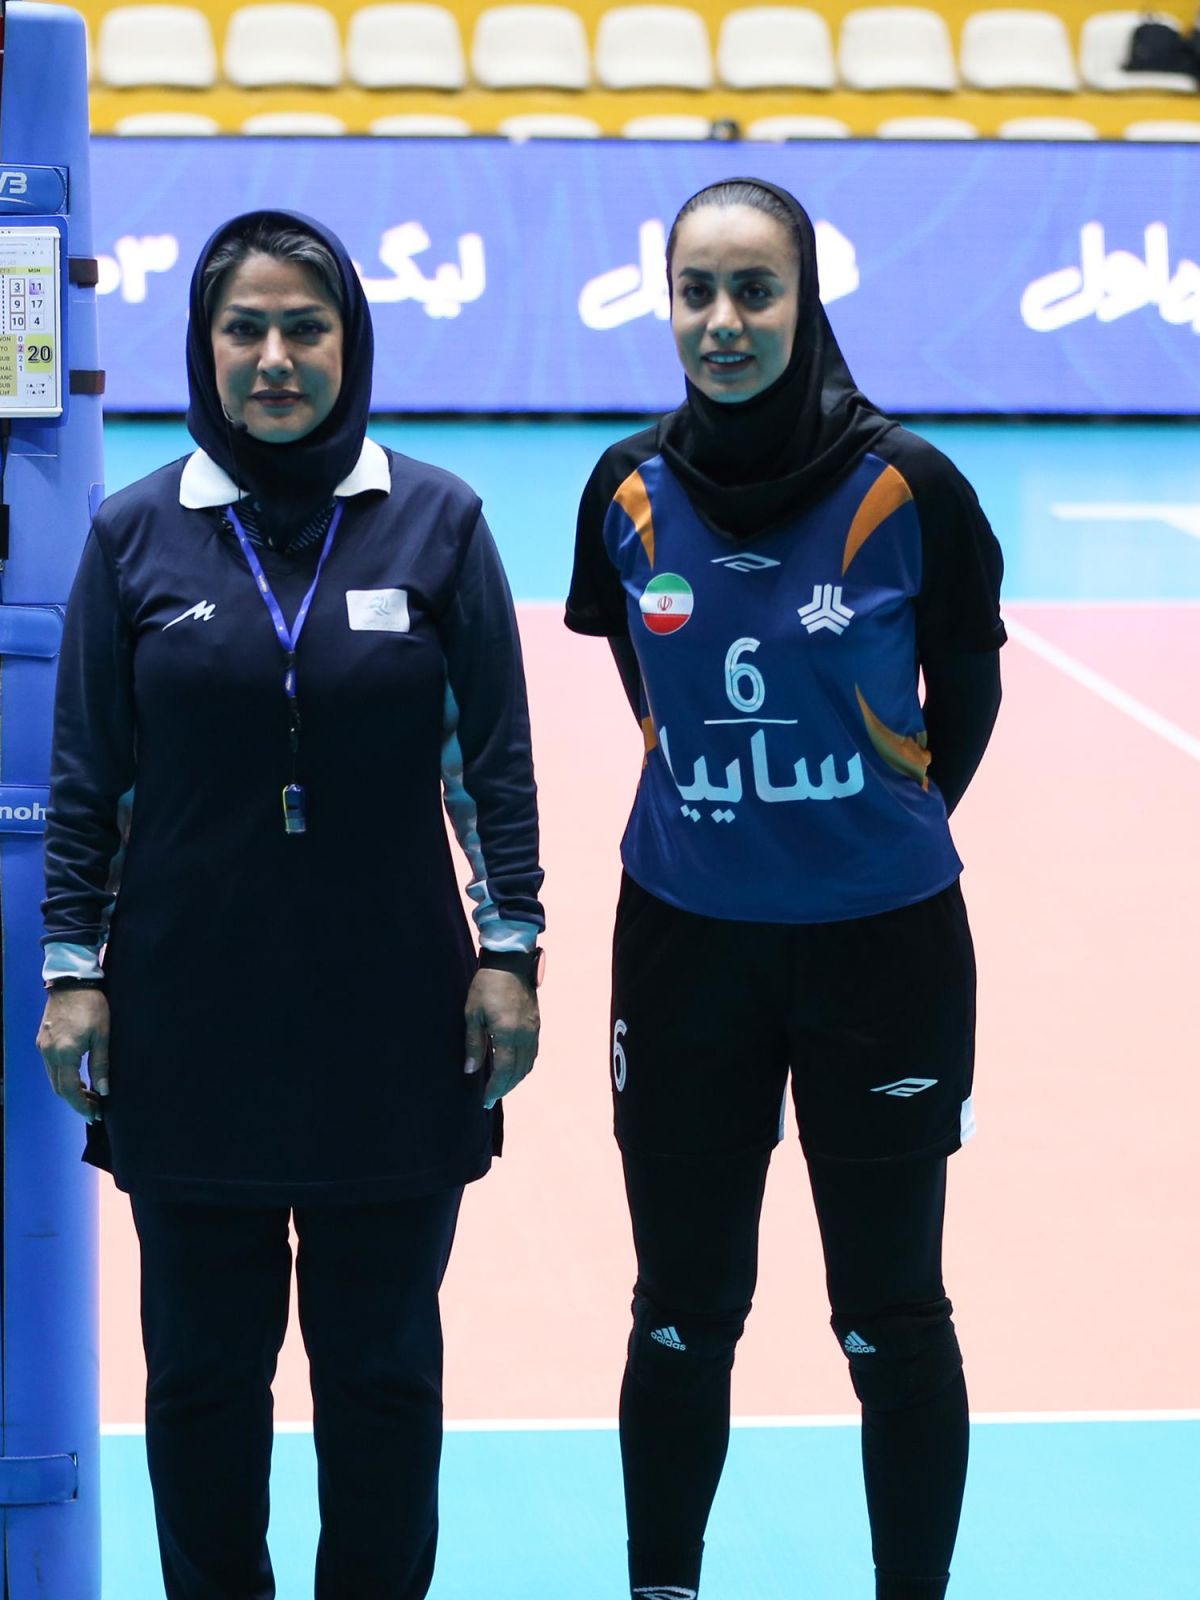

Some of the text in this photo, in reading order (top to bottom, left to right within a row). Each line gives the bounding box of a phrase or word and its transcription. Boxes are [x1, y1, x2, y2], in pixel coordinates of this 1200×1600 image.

[14, 283, 21, 291] 3
[31, 282, 42, 291] 11
[14, 300, 21, 309] 9
[31, 300, 43, 308] 17
[12, 317, 24, 326] 10
[33, 317, 40, 325] 4
[27, 345, 53, 363] 20
[724, 637, 766, 713] 6
[612, 1018, 628, 1093] 6
[650, 1331, 686, 1351] adidas
